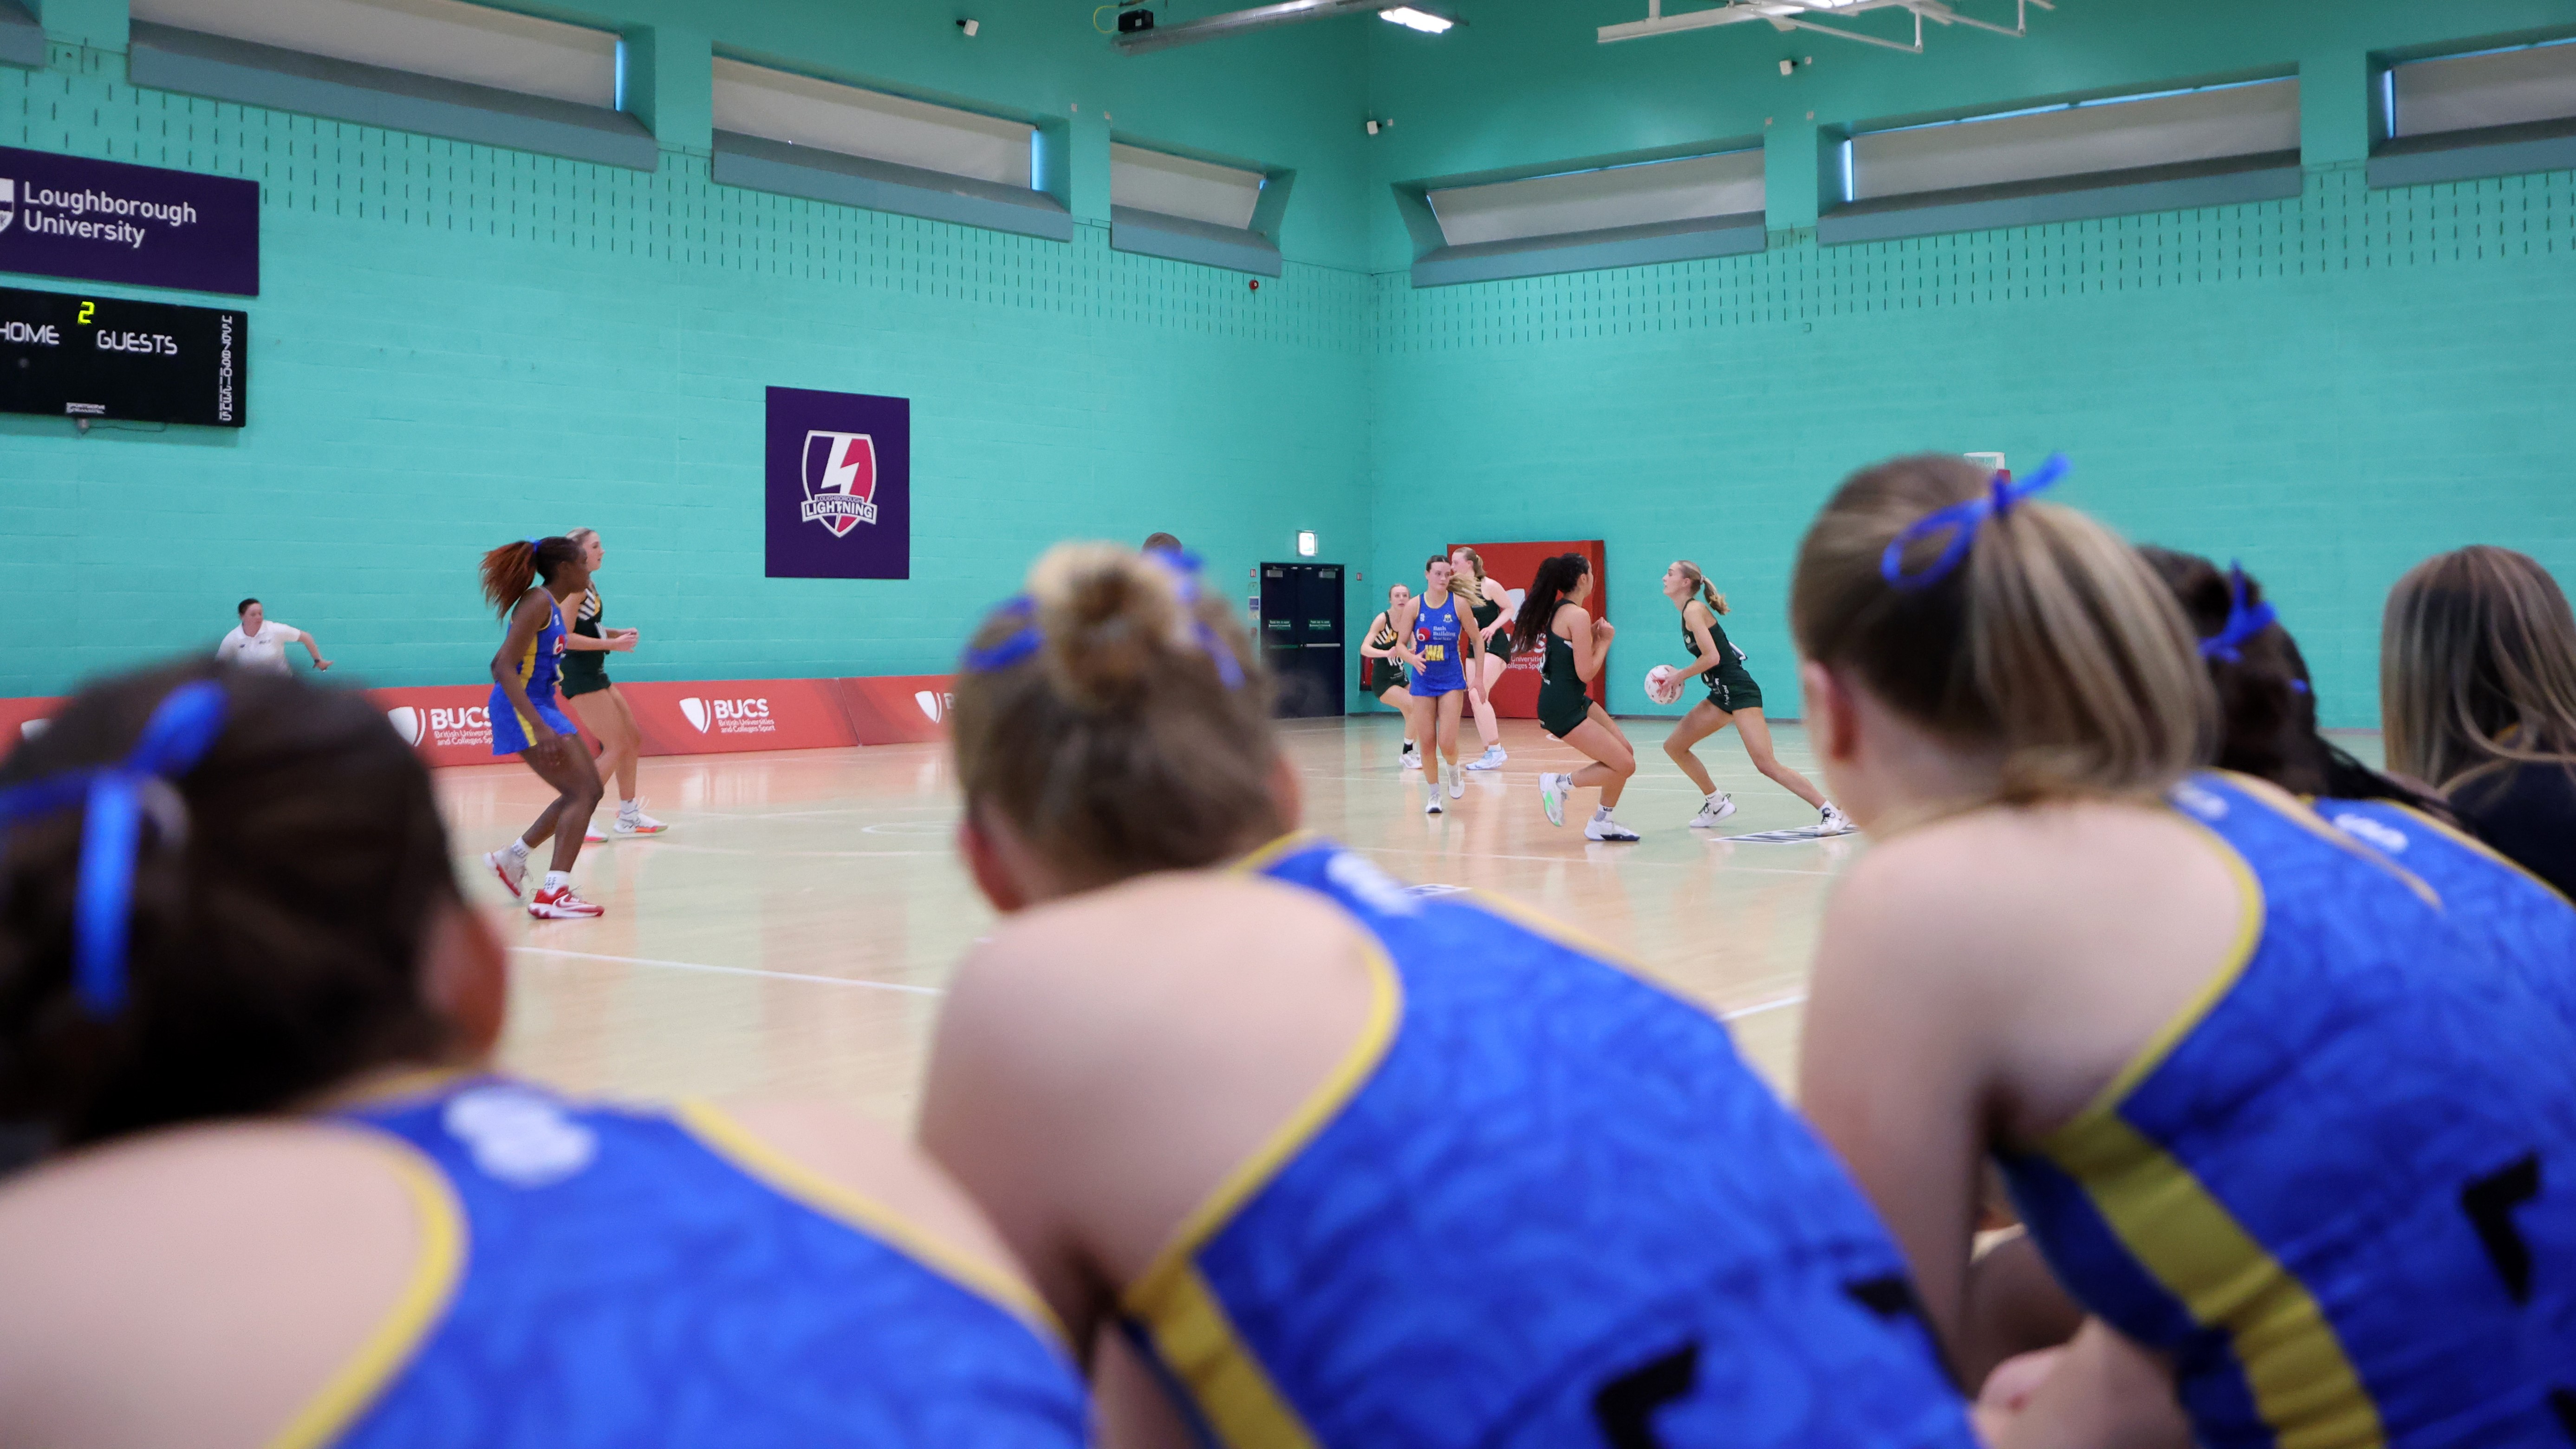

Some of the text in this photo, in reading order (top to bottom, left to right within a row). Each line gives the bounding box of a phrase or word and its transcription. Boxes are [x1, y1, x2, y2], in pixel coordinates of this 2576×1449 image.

[24, 181, 196, 226] Loughborough
[24, 209, 145, 248] University
[78, 301, 95, 325] 2
[0, 321, 60, 345] HOME
[97, 330, 177, 354] GUESTS
[806, 501, 873, 518] LIGHTNING
[714, 698, 770, 719] BUCS
[434, 729, 459, 739] British
[758, 724, 776, 733] Sport
[437, 737, 451, 746] and
[451, 736, 483, 746] Colleges
